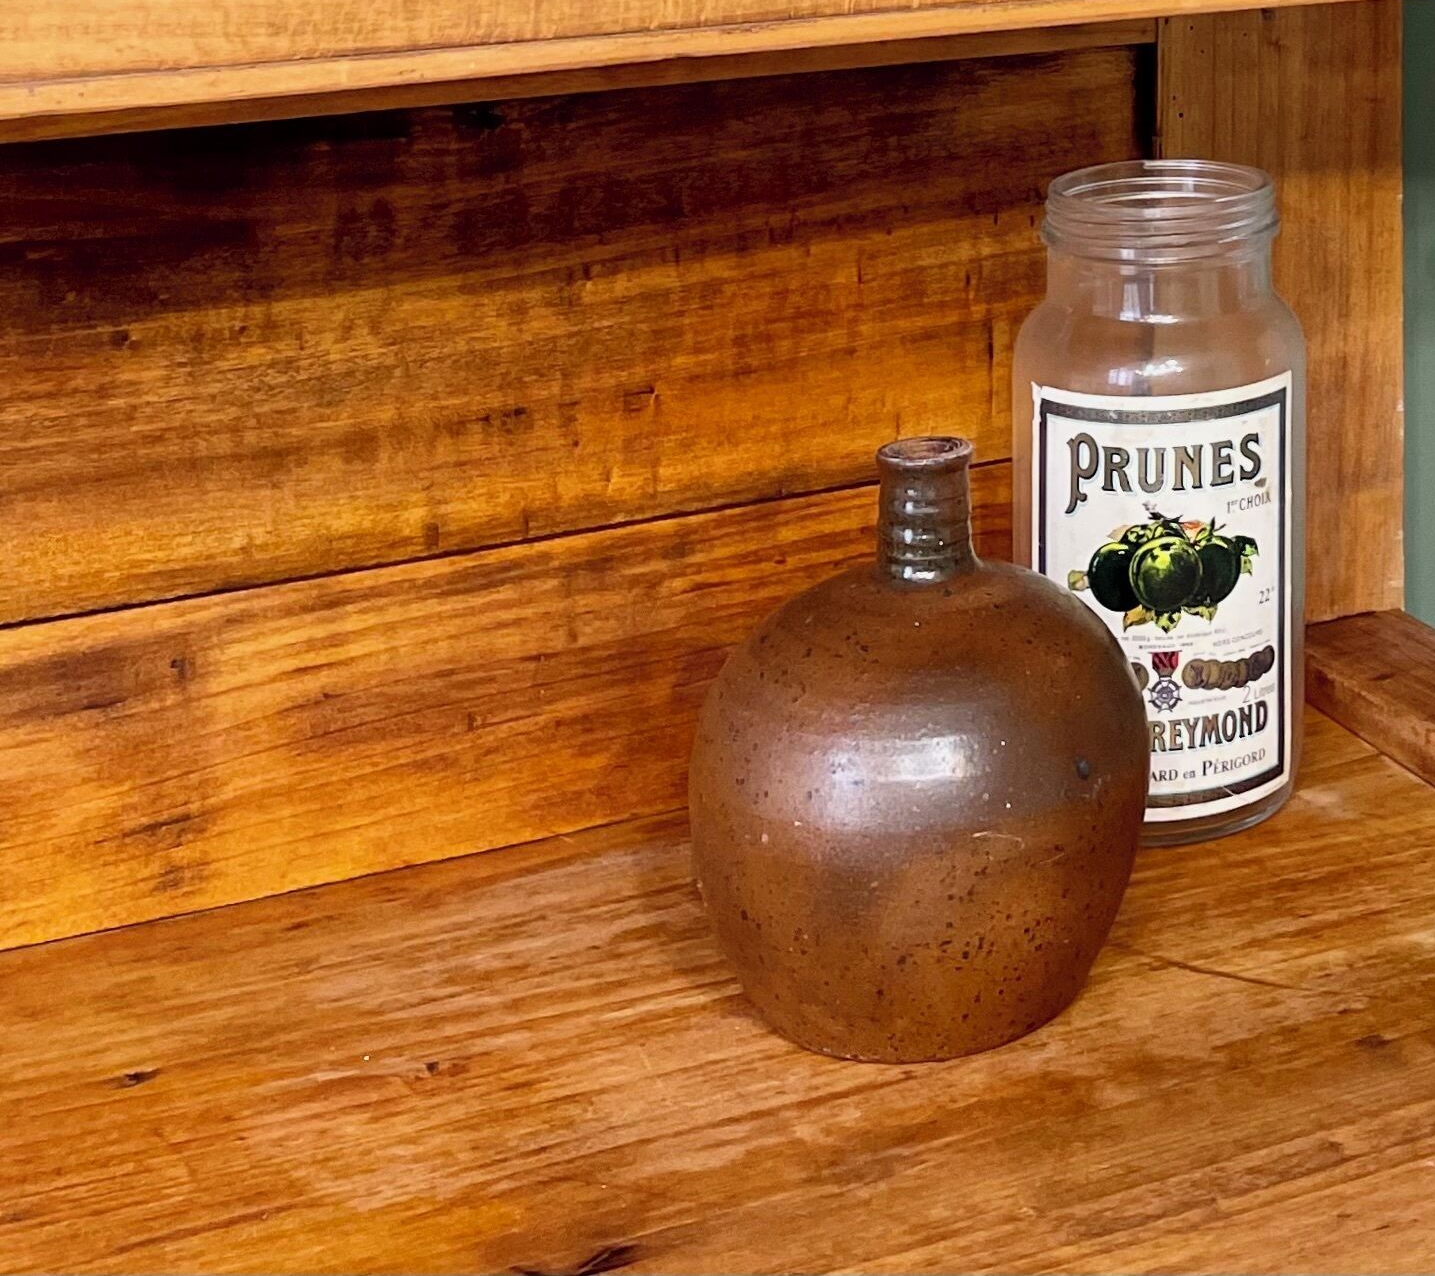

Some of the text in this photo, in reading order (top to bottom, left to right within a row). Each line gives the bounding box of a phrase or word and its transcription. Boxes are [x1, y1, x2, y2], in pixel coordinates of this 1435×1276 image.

[1064, 432, 1262, 514] PRUNES
[1239, 491, 1271, 511] CHOIX
[1183, 770, 1196, 780] en
[1202, 748, 1266, 777] PÉRIGORD
